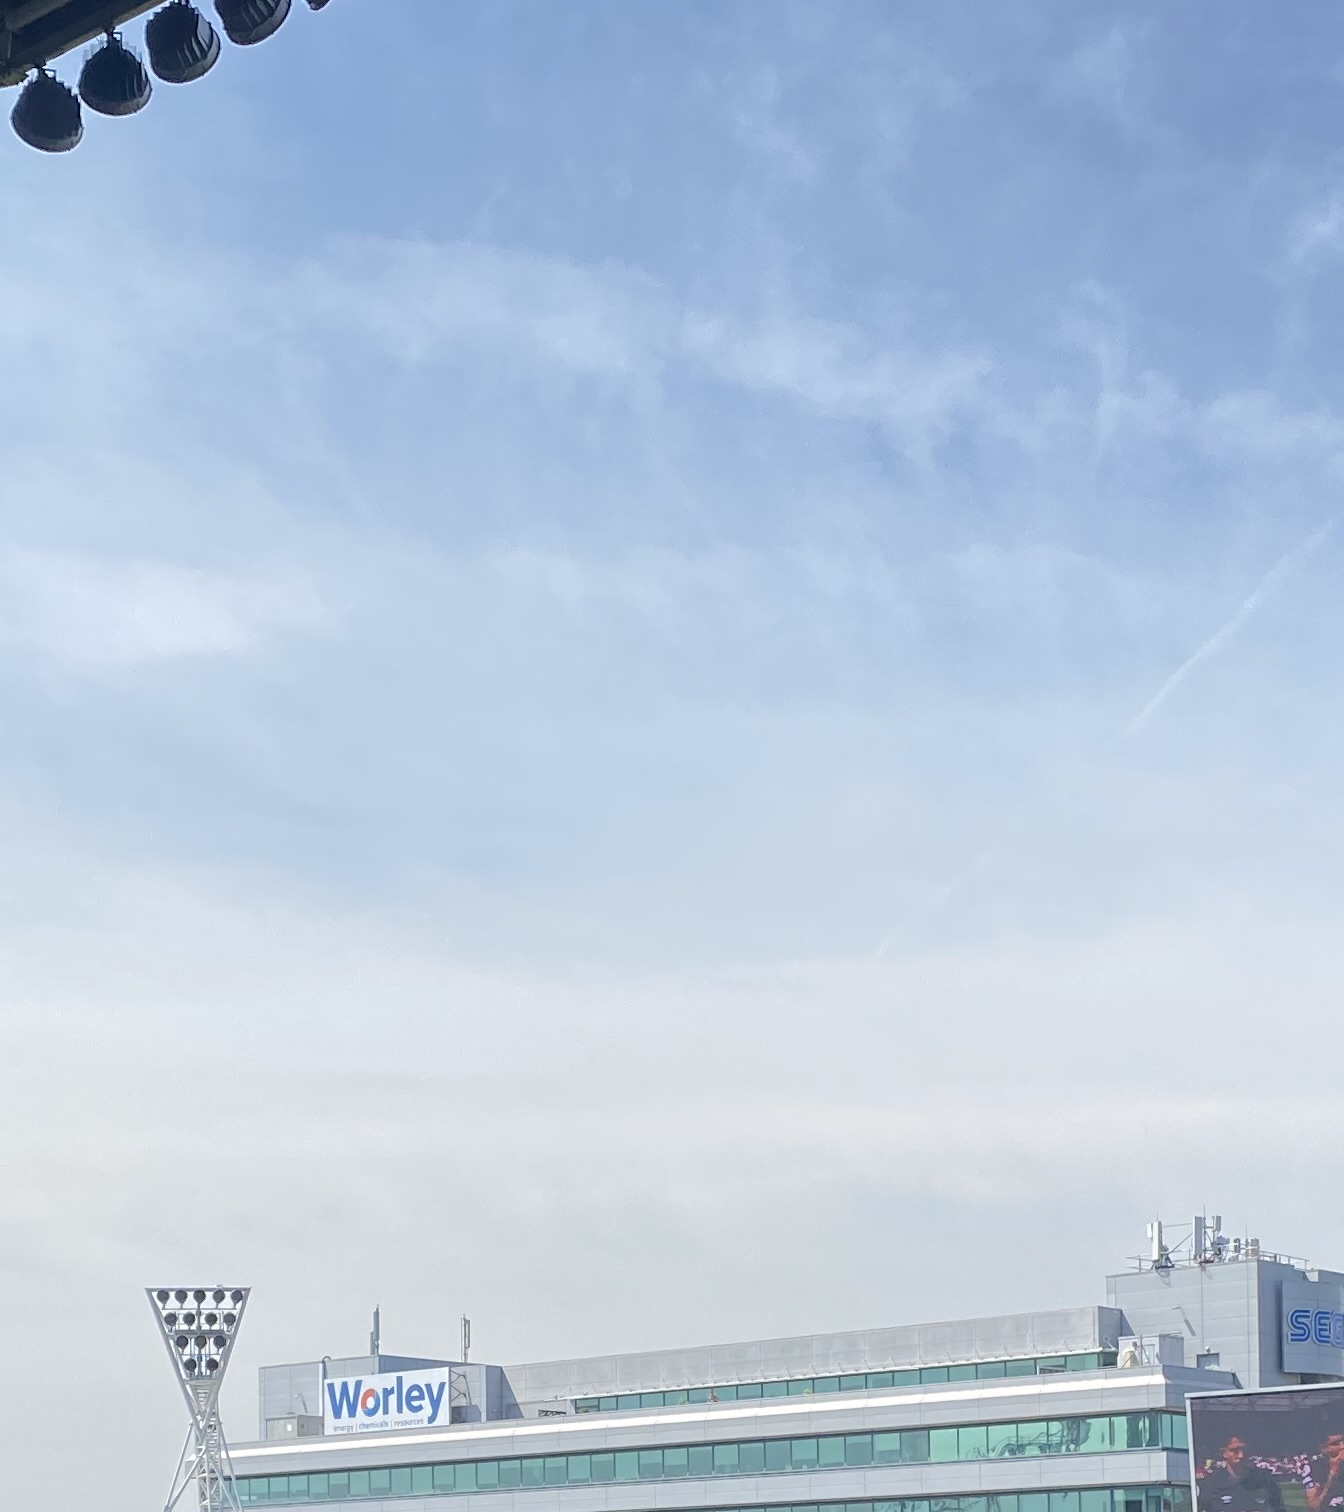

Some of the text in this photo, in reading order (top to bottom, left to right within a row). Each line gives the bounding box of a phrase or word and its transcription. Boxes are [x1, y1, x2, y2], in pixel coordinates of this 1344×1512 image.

[326, 1376, 446, 1425] Worley
[333, 1419, 423, 1433] energy chemicals resources
